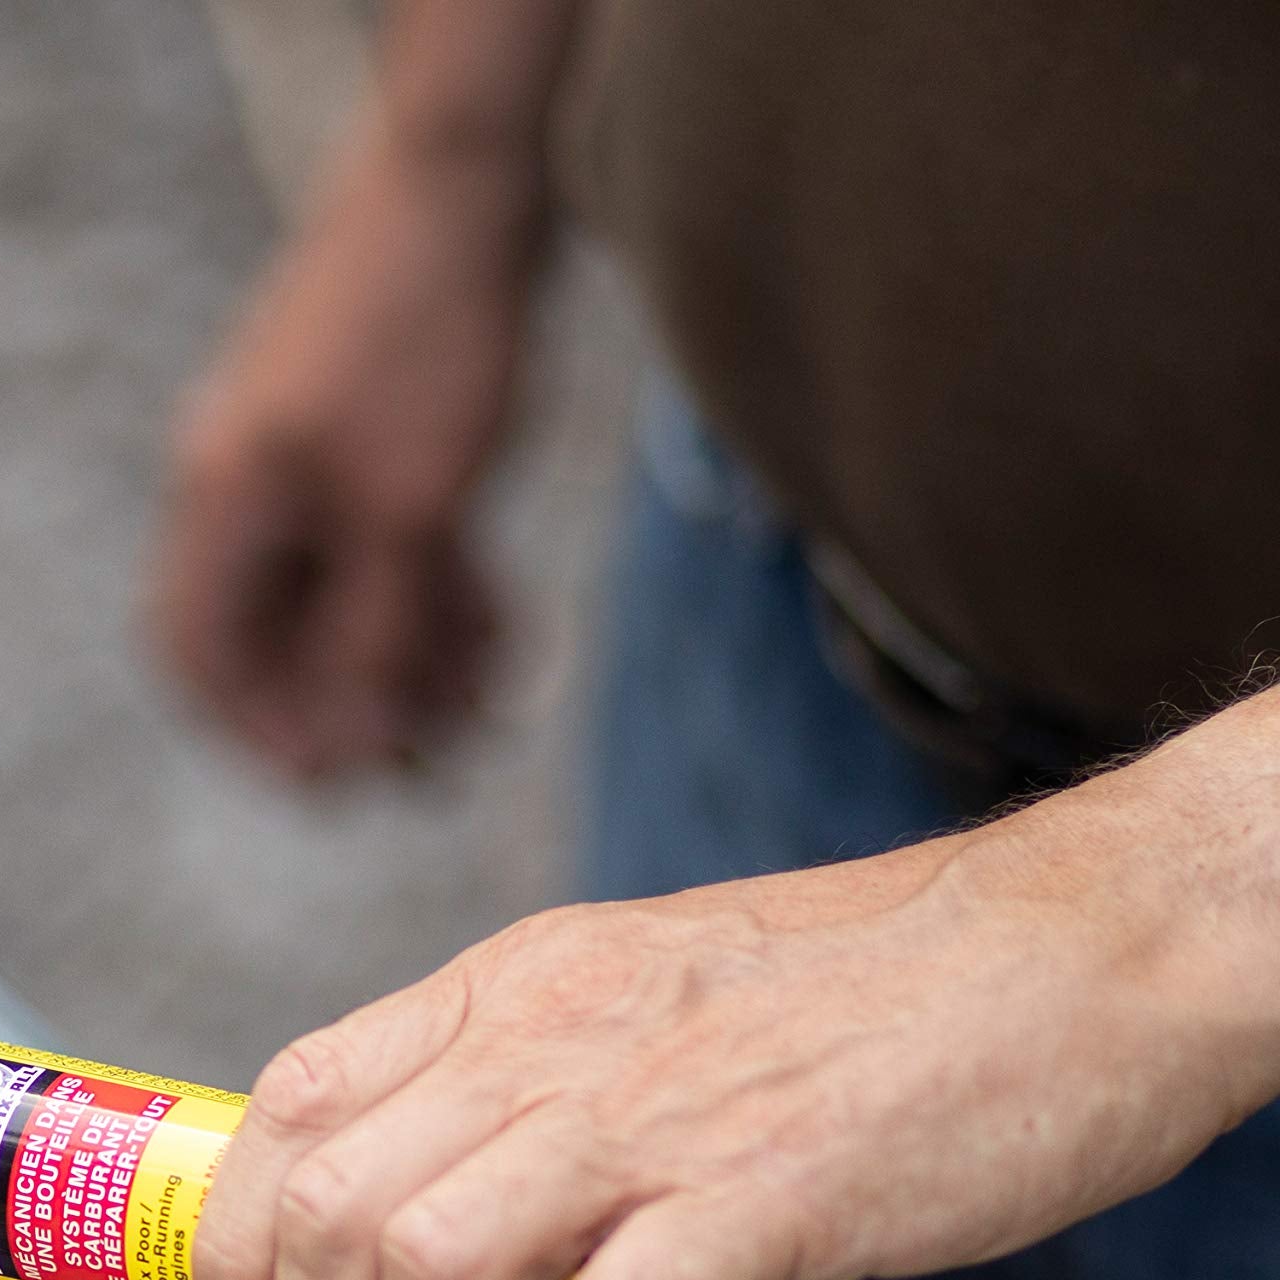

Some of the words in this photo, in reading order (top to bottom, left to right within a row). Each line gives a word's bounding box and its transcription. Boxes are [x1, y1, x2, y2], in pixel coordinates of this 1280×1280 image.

[14, 1134, 47, 1280] MÉCANICIEN
[35, 1077, 83, 1129] DANS
[35, 1090, 95, 1221] BOUTEILLE
[62, 1150, 94, 1267] SYSTÈME
[81, 1113, 111, 1145] DE
[83, 1118, 130, 1270] CARBURANT
[100, 1095, 173, 1270] RÉPARER-TOUT
[35, 1227, 57, 1273] UNE
[137, 1217, 151, 1263] Poor
